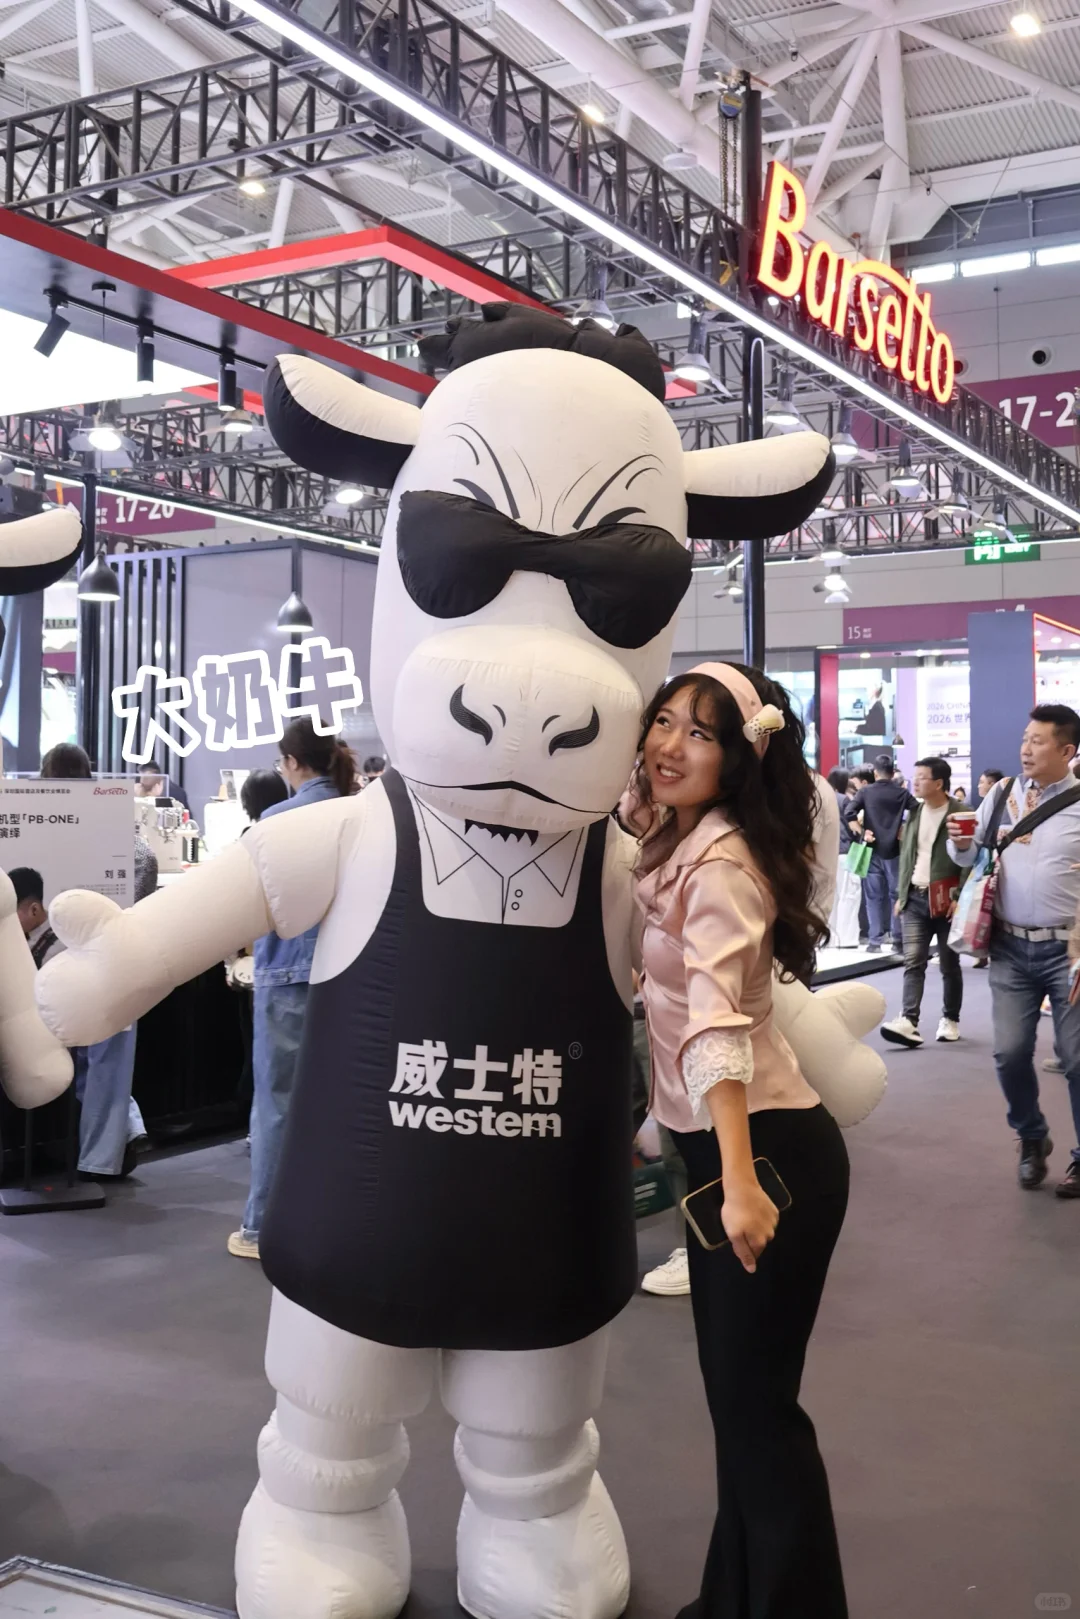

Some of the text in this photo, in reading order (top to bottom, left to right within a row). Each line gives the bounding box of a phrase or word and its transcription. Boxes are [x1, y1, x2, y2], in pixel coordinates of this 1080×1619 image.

[757, 160, 955, 405] Barsetto
[848, 626, 861, 640] 15
[927, 713, 952, 724] 2026
[93, 787, 128, 796] Barsetto
[388, 1039, 562, 1105] 威士特
